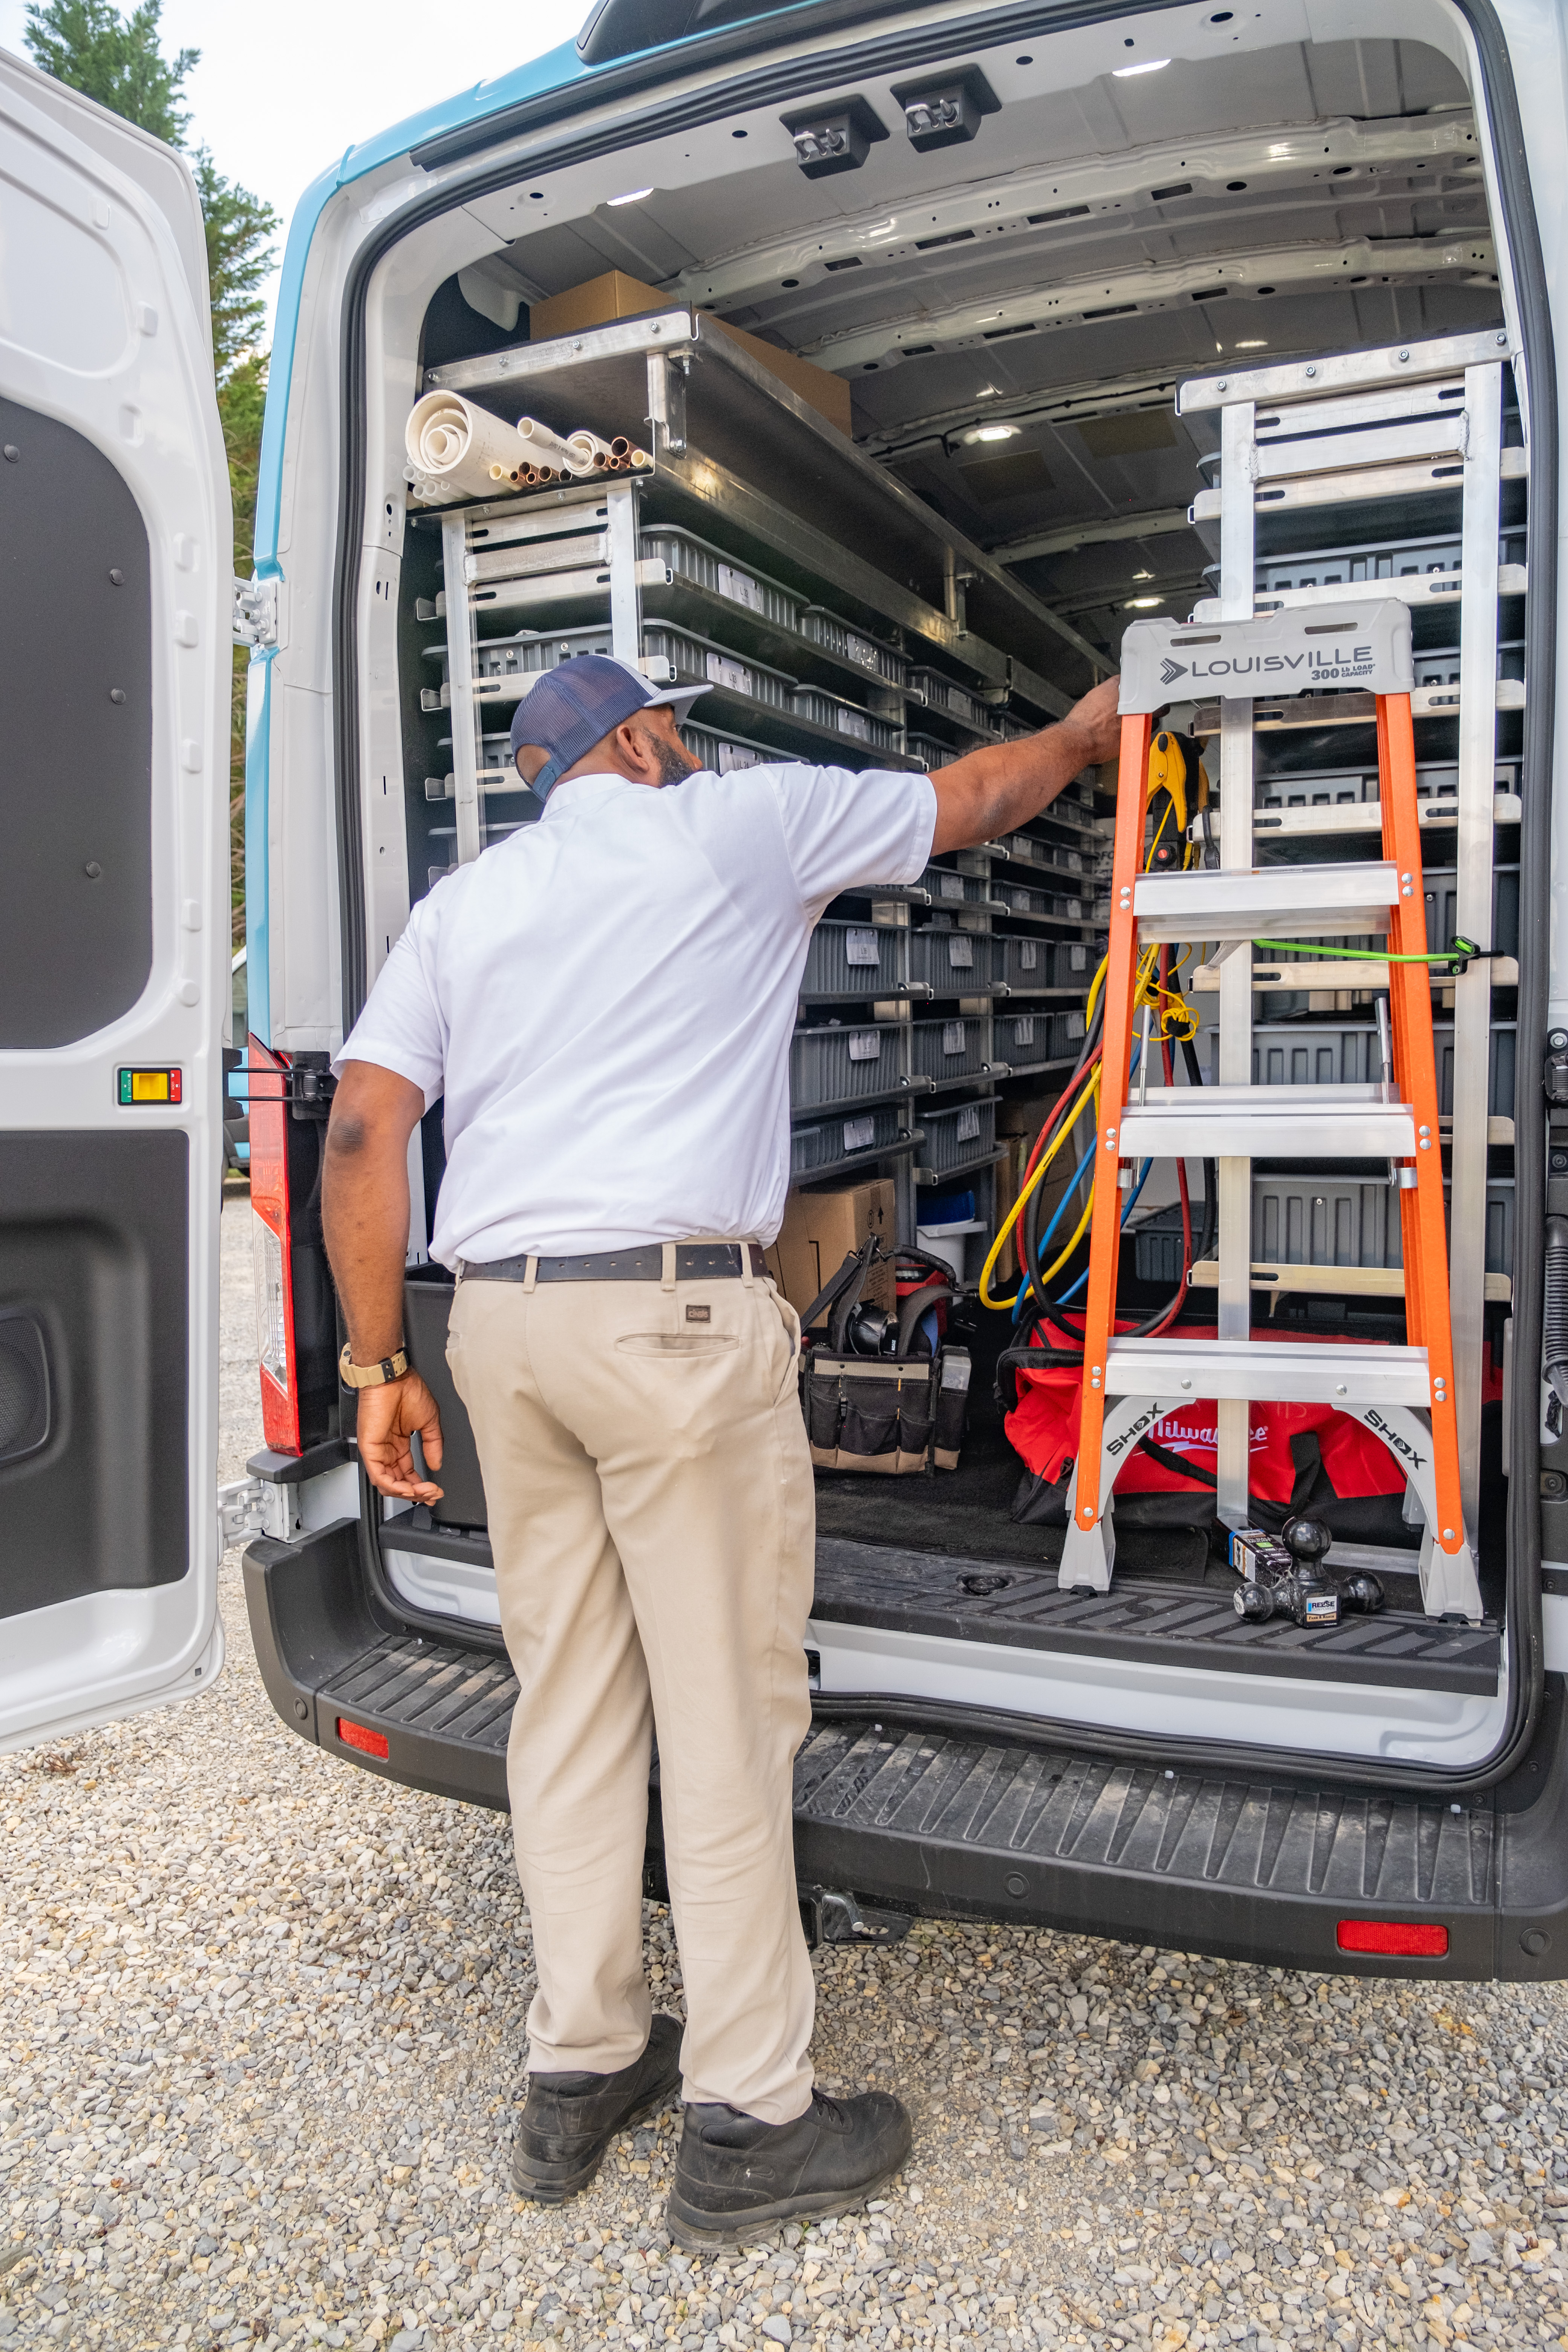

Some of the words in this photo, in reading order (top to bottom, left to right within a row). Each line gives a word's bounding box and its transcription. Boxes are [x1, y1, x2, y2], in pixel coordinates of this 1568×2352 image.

[1192, 646, 1373, 677] LOUISVILLE
[1311, 668, 1339, 680] 300
[993, 1239, 1003, 1256] COMPATIBLE
[1106, 1402, 1164, 1455] SHOX
[1364, 1409, 1428, 1470] SHOX
